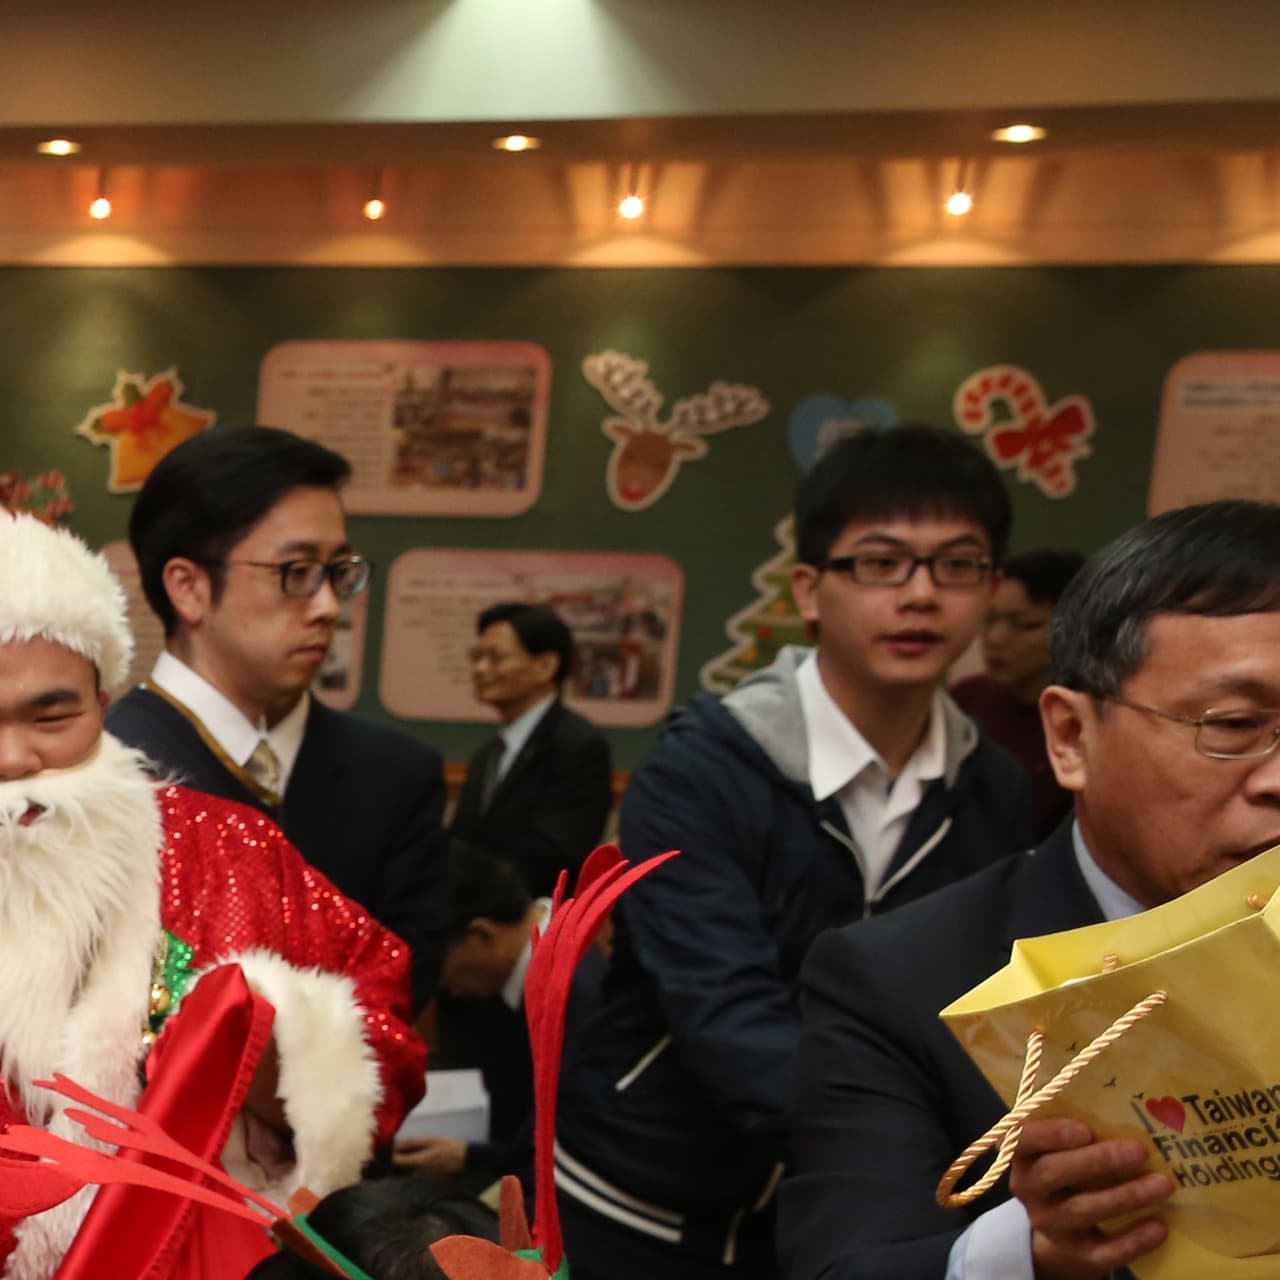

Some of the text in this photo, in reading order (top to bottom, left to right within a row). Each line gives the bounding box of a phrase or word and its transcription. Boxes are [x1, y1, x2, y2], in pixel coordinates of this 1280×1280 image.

[1181, 1084, 1280, 1126] Taiwan
[1151, 1114, 1280, 1163] Financi
[1172, 1154, 1280, 1188] Holding
